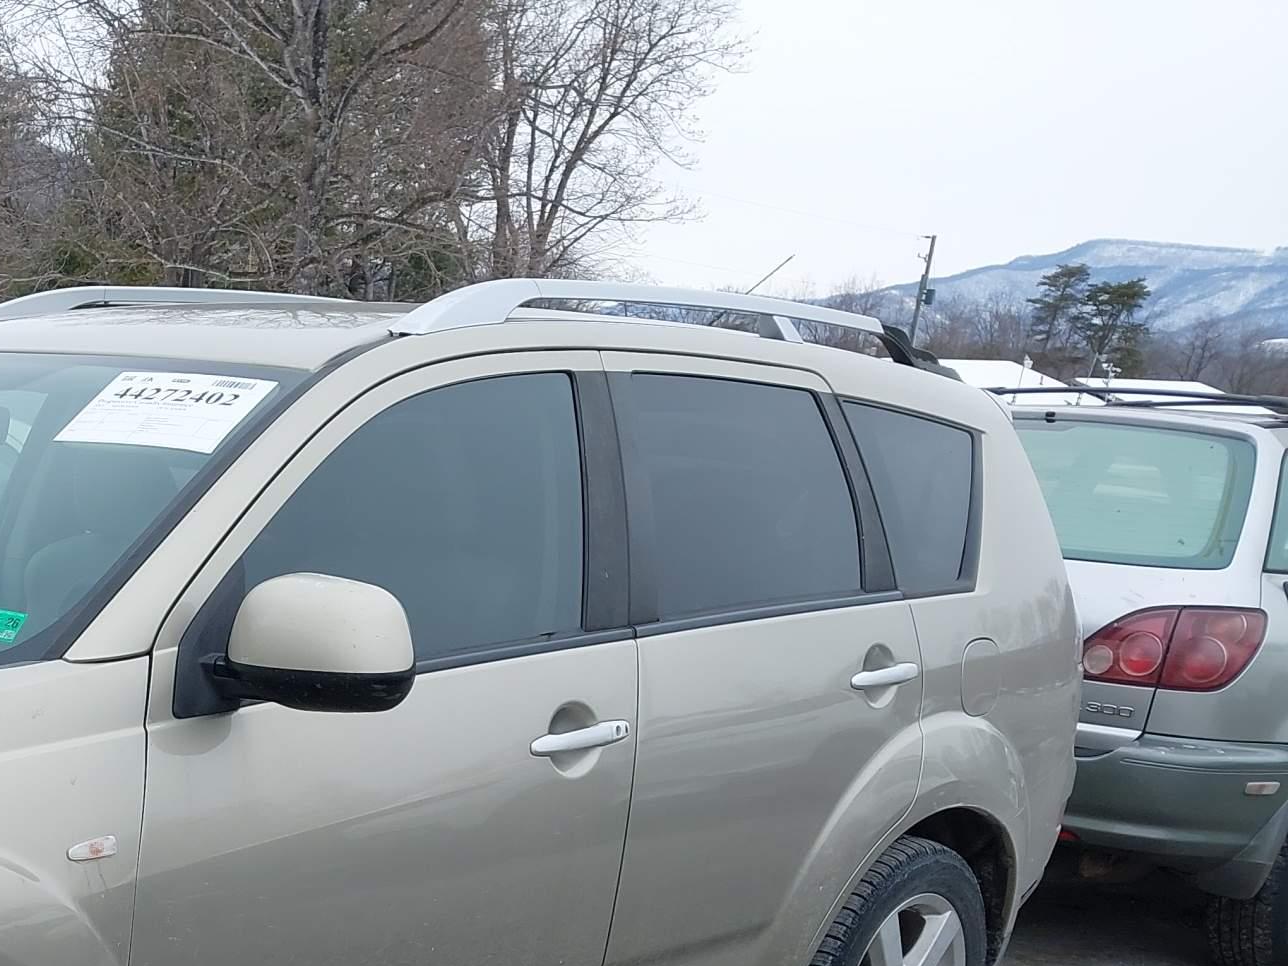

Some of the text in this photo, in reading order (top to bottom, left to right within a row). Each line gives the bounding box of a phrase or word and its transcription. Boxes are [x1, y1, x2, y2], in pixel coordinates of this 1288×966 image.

[114, 386, 240, 406] 44272402
[5, 617, 21, 629] 26
[1085, 701, 1135, 718] 300
